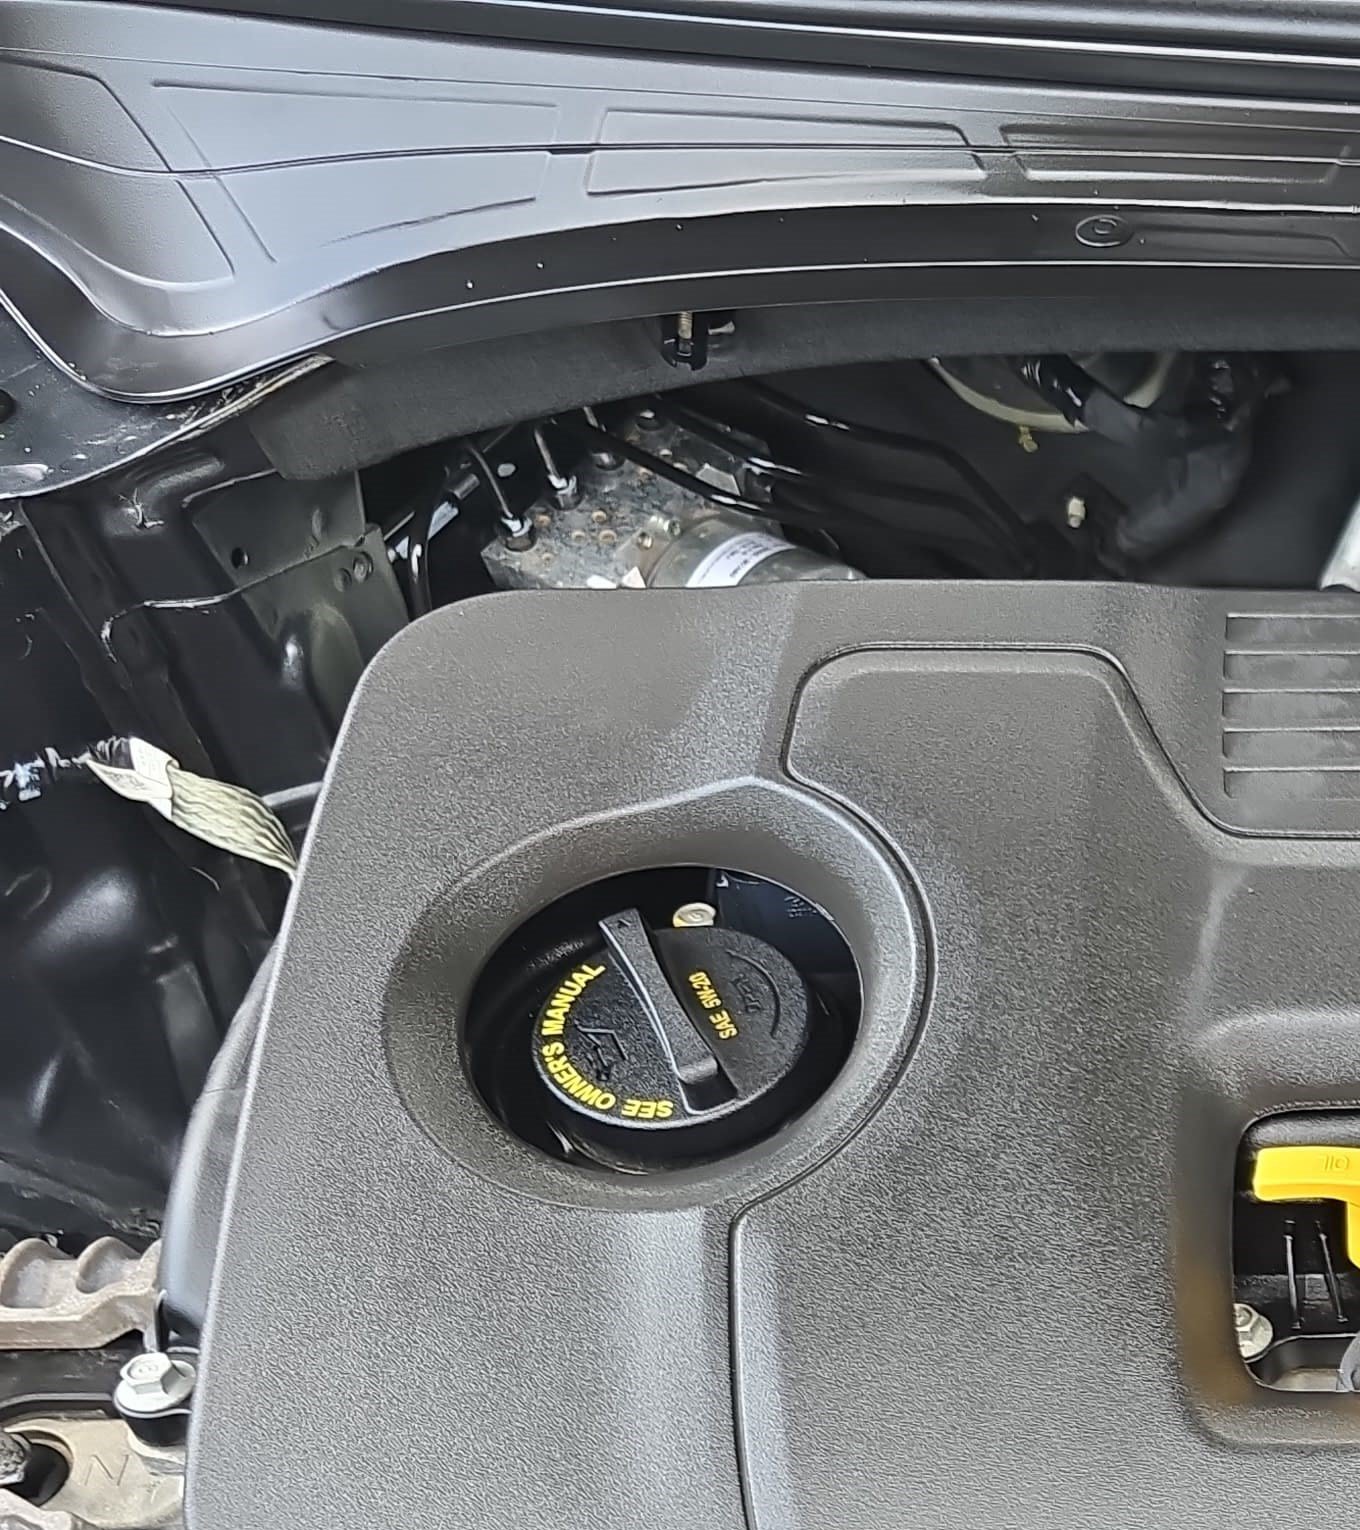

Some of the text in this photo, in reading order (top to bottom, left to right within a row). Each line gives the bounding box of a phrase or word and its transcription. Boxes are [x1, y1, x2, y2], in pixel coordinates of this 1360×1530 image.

[689, 971, 738, 1039] SAE 5W-20
[541, 964, 674, 1119] SEE OWNER'S MANUAL
[1320, 1153, 1351, 1174] OIL
